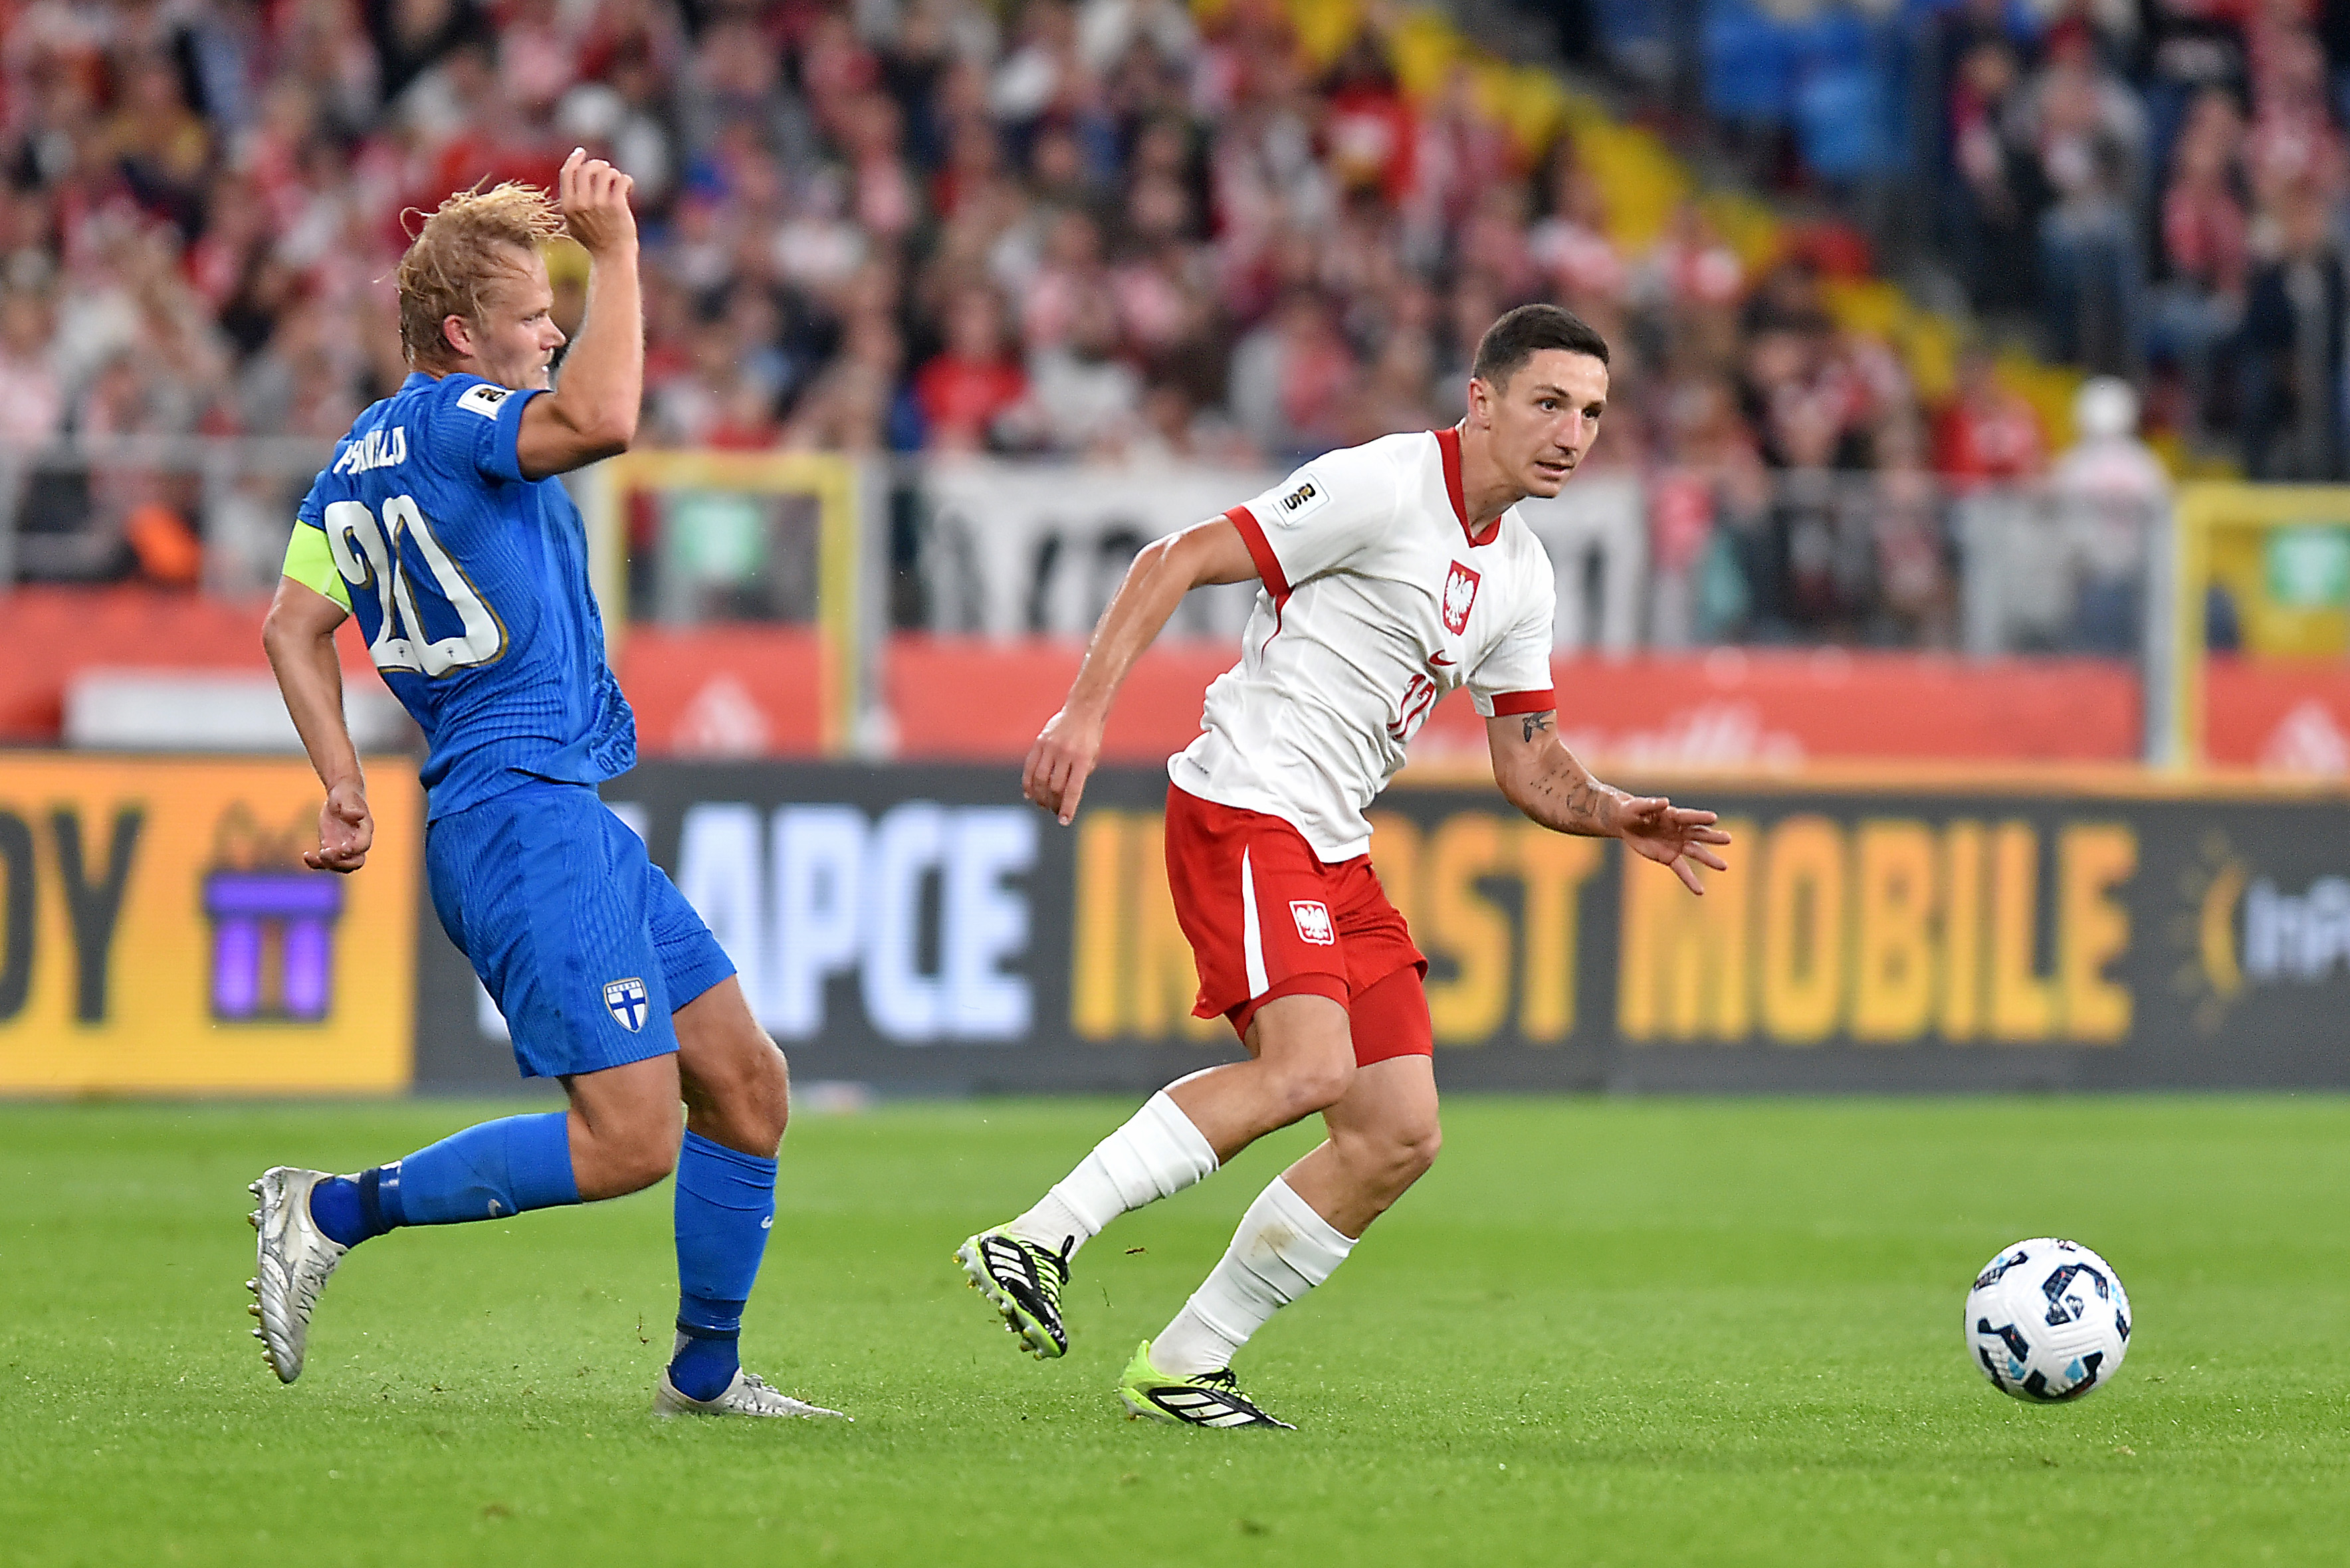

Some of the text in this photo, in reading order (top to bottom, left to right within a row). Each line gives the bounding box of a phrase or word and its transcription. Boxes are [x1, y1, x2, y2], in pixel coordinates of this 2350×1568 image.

[324, 494, 508, 678] 20
[477, 801, 2136, 1044] APCE INST MOBILE
